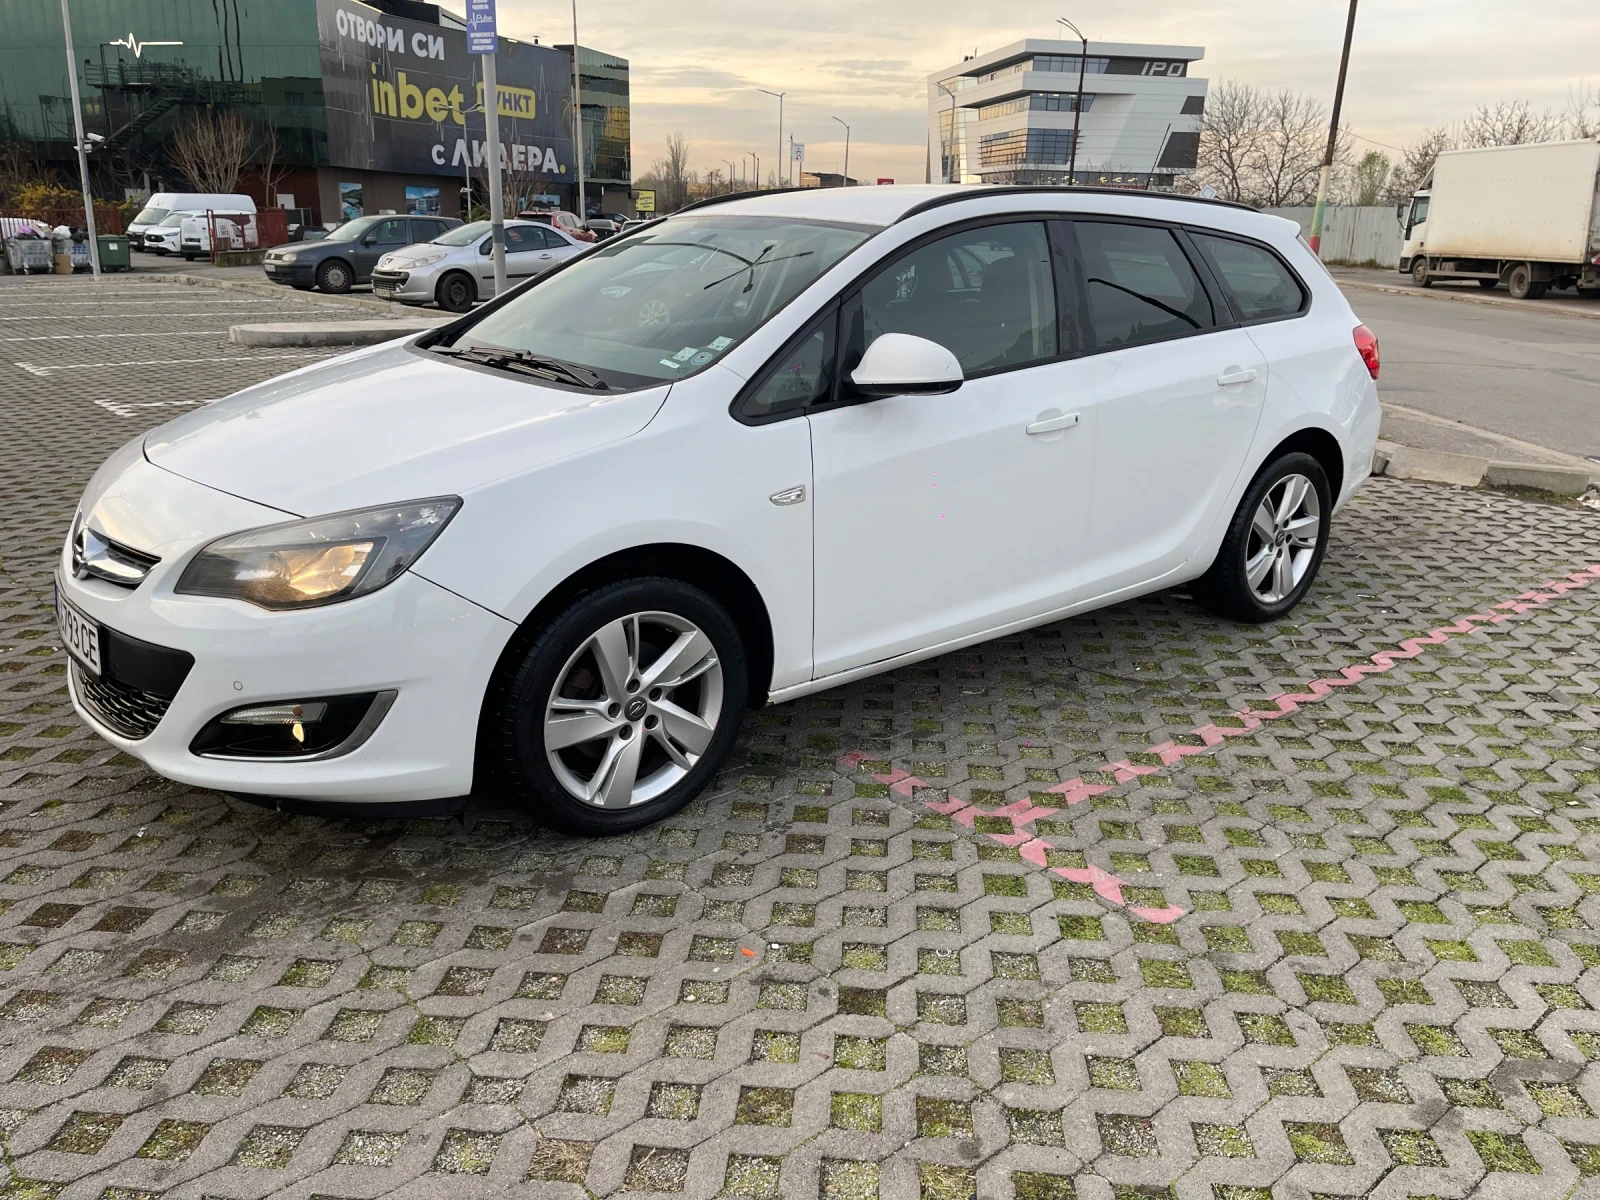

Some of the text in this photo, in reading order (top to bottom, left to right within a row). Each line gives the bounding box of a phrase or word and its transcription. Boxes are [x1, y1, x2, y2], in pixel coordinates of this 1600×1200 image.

[336, 8, 445, 60] ОТВОРИ СИ
[1141, 61, 1185, 77] IPO
[371, 62, 465, 125] inbet
[481, 88, 532, 113] НКТ
[81, 622, 98, 667] CE
